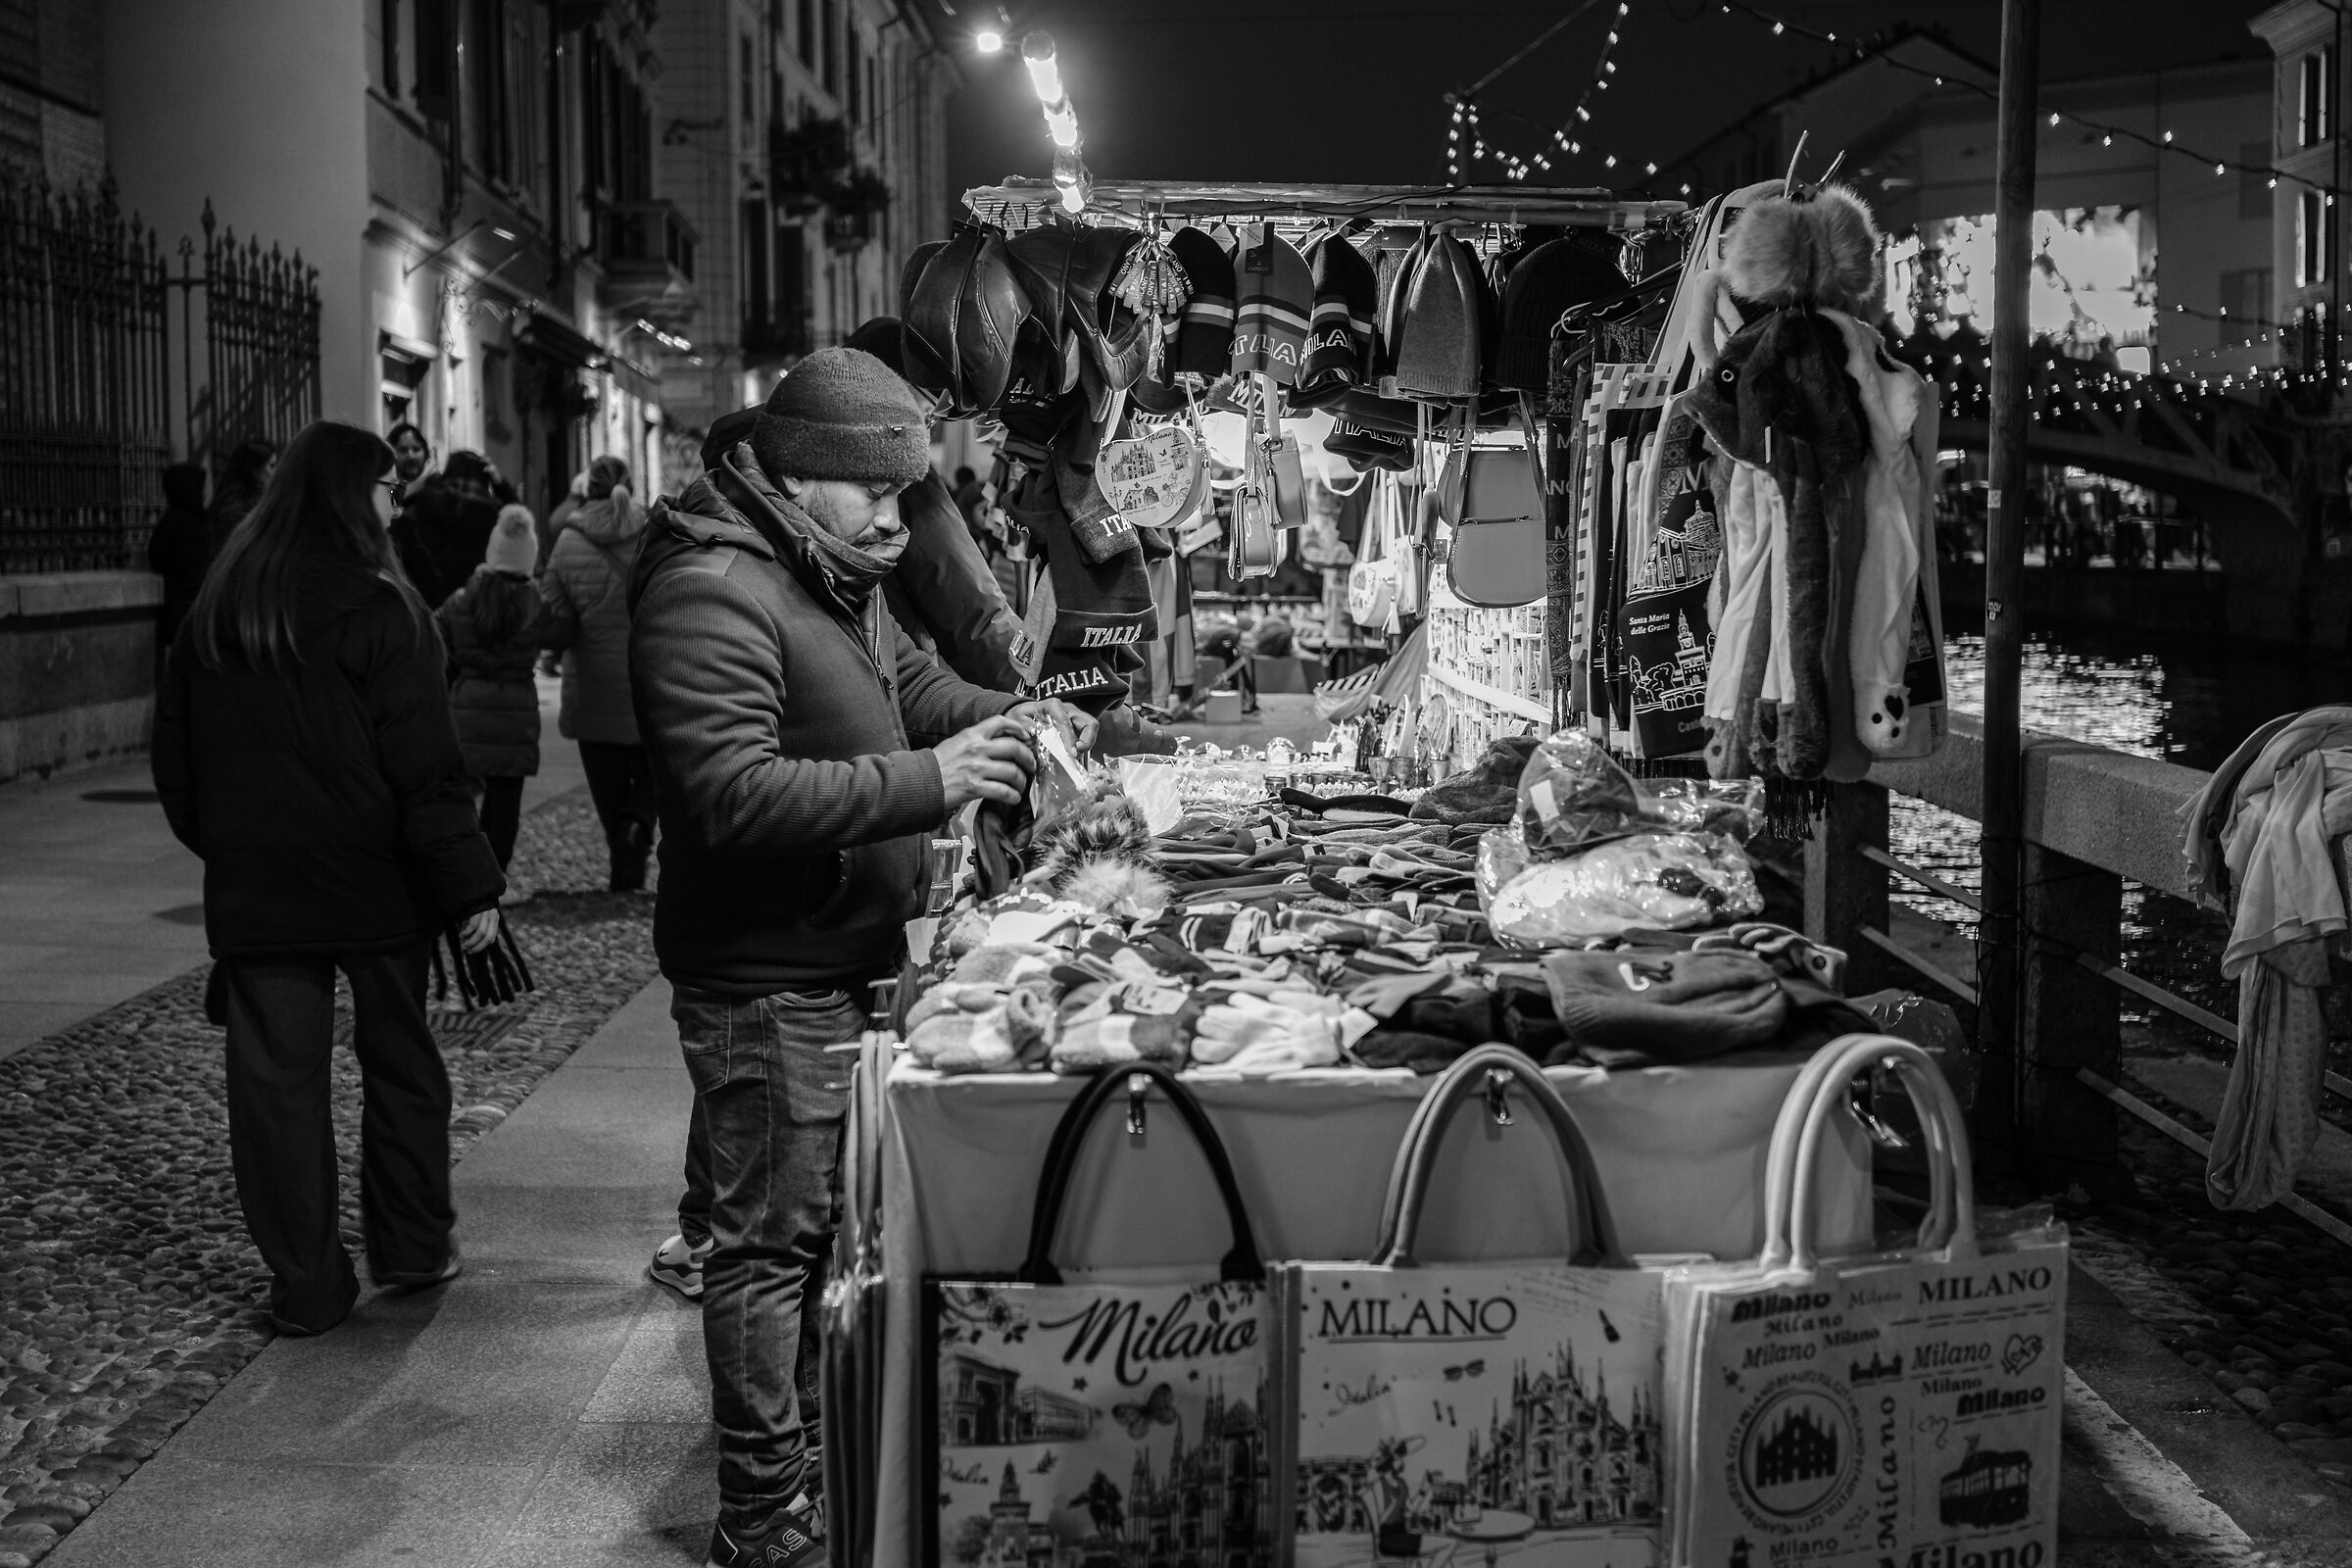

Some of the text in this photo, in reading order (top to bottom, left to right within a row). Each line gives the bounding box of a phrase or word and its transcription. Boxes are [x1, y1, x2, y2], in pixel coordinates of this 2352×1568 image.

[1144, 431, 1173, 443] Milano
[1629, 612, 1670, 626] Santa Maria
[1631, 622, 1670, 636] delle Grazie
[1080, 623, 1143, 648] ITALIA
[1035, 666, 1108, 702] ITALIA
[1918, 1266, 2051, 1305] MILANO
[1848, 1289, 1902, 1308] Milano
[1318, 1297, 1517, 1338] MILANO
[1763, 1314, 1843, 1339] Milano
[1038, 1293, 1258, 1387] Milano
[1823, 1327, 1880, 1350] Milano
[1741, 1340, 1817, 1370] Milano
[1911, 1342, 1991, 1371] Milano
[1920, 1376, 1983, 1397] Milano
[1876, 1396, 1899, 1549] Milano
[1769, 1536, 1838, 1559] Milano
